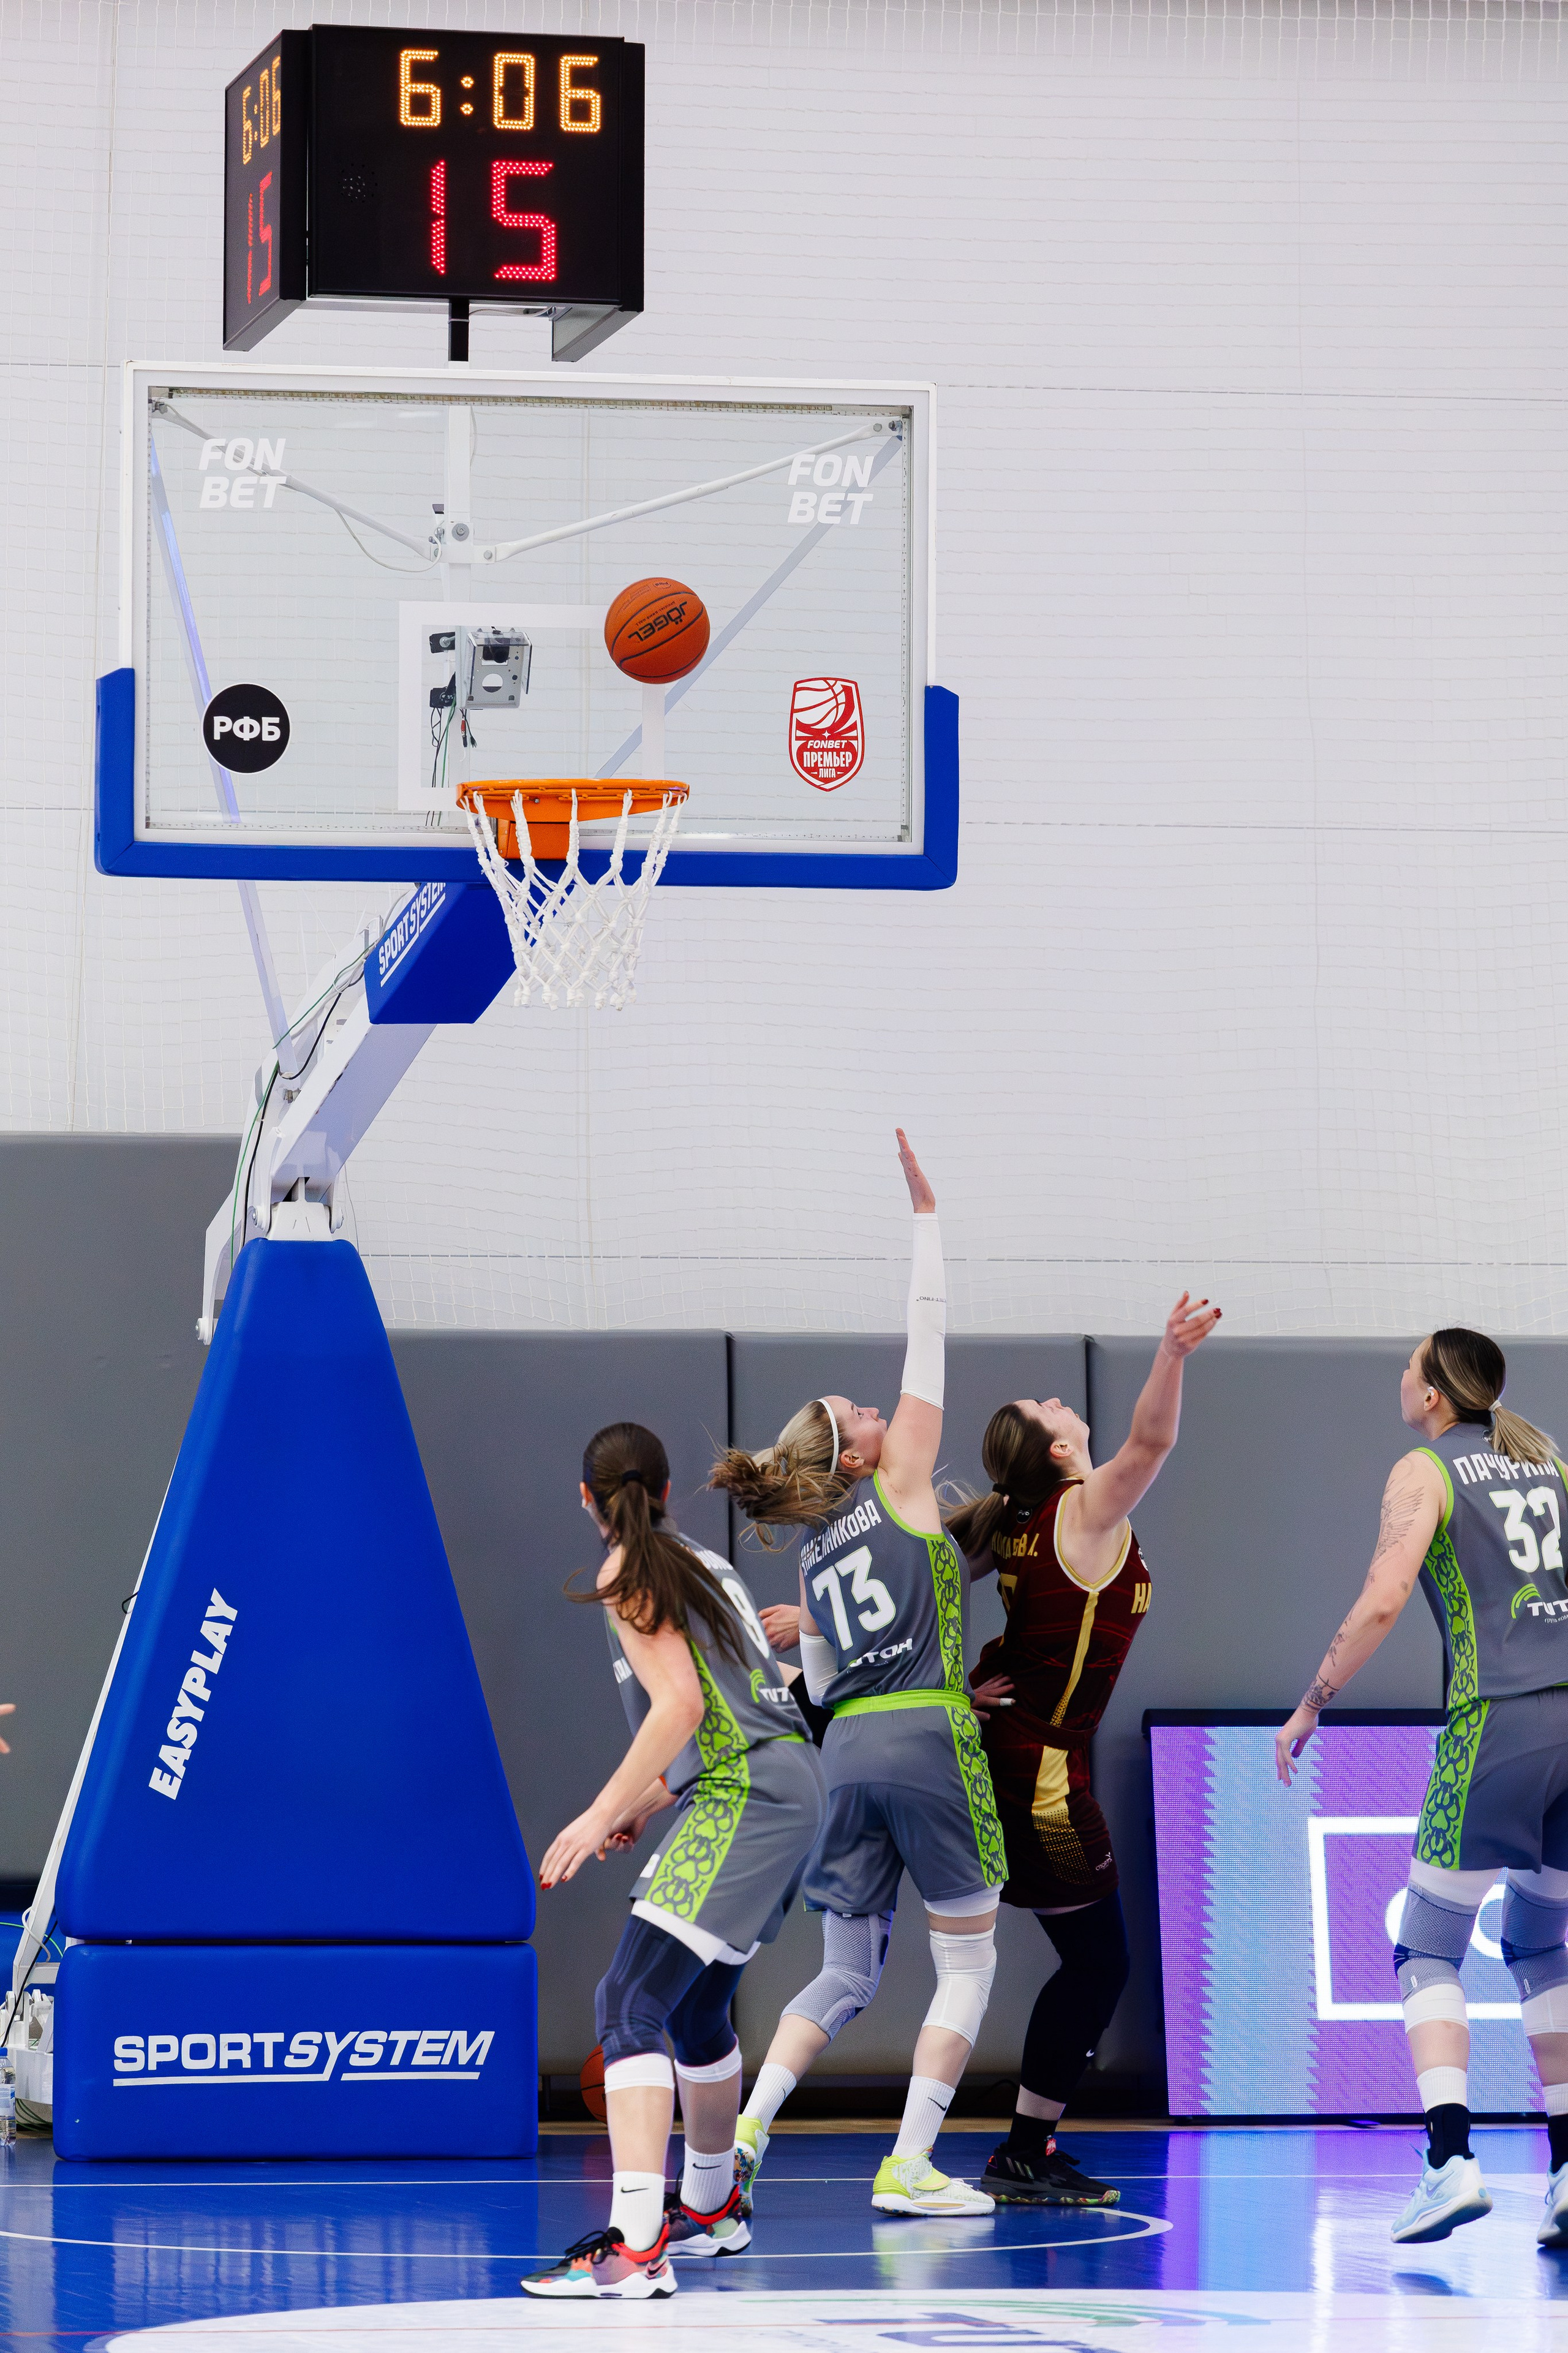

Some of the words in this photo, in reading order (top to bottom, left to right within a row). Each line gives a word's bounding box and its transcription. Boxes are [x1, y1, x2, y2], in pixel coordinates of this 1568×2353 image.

[242, 55, 281, 165] 6:06
[399, 49, 601, 133] 6:06
[247, 171, 273, 304] 15
[431, 160, 557, 281] 15
[198, 437, 286, 470] FON
[788, 454, 875, 488] FON
[199, 476, 287, 509] BET
[787, 492, 873, 525] BET
[628, 601, 687, 641] JÖGEL
[213, 716, 281, 741] РФБ
[807, 739, 848, 749] FONBET
[803, 751, 853, 768] ПРЕМЬЕР
[818, 768, 836, 778] ЛИГА
[1488, 1486, 1563, 1573] 32
[812, 1545, 896, 1651] 73
[148, 1587, 238, 1800] EASYPLAY
[113, 2030, 495, 2082] SPORTSYSTEM
